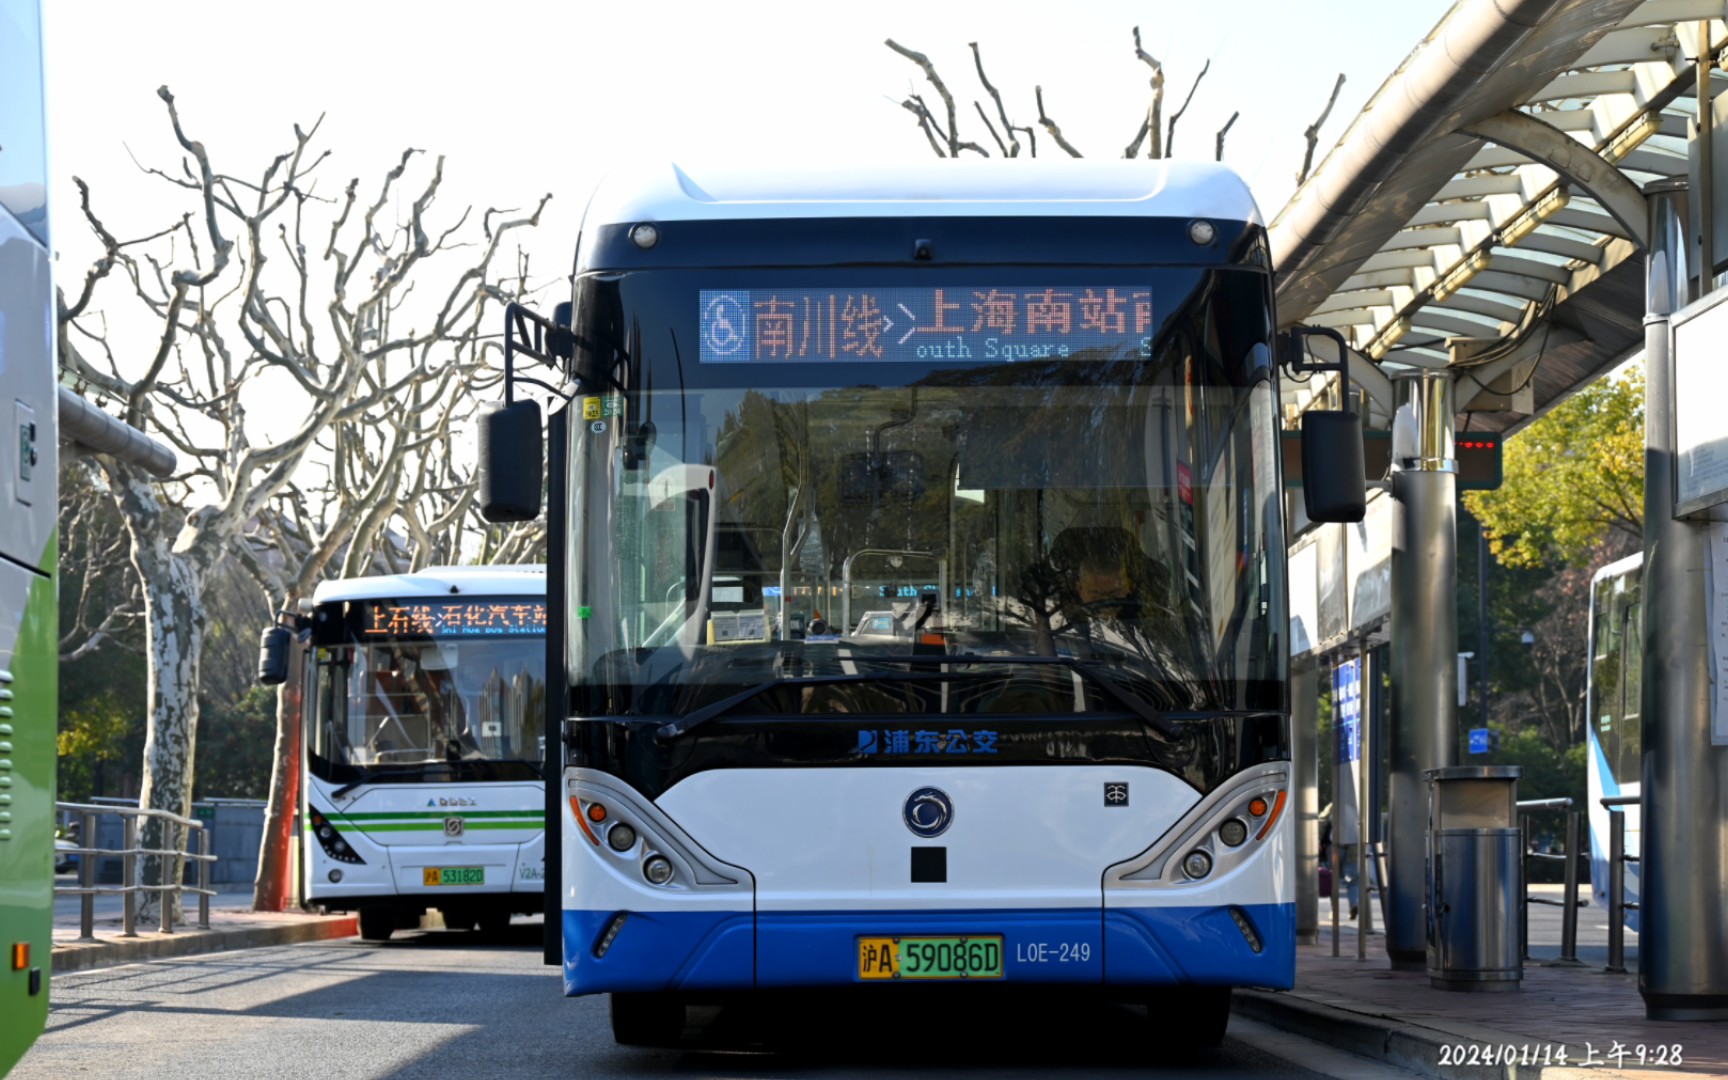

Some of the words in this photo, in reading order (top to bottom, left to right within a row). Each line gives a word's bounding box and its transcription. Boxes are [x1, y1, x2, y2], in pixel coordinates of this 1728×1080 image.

[754, 295, 883, 359] 南川线
[917, 337, 972, 358] outh
[984, 338, 1069, 362] Square
[365, 605, 435, 634] 上石线
[884, 730, 998, 754] 浦东公交
